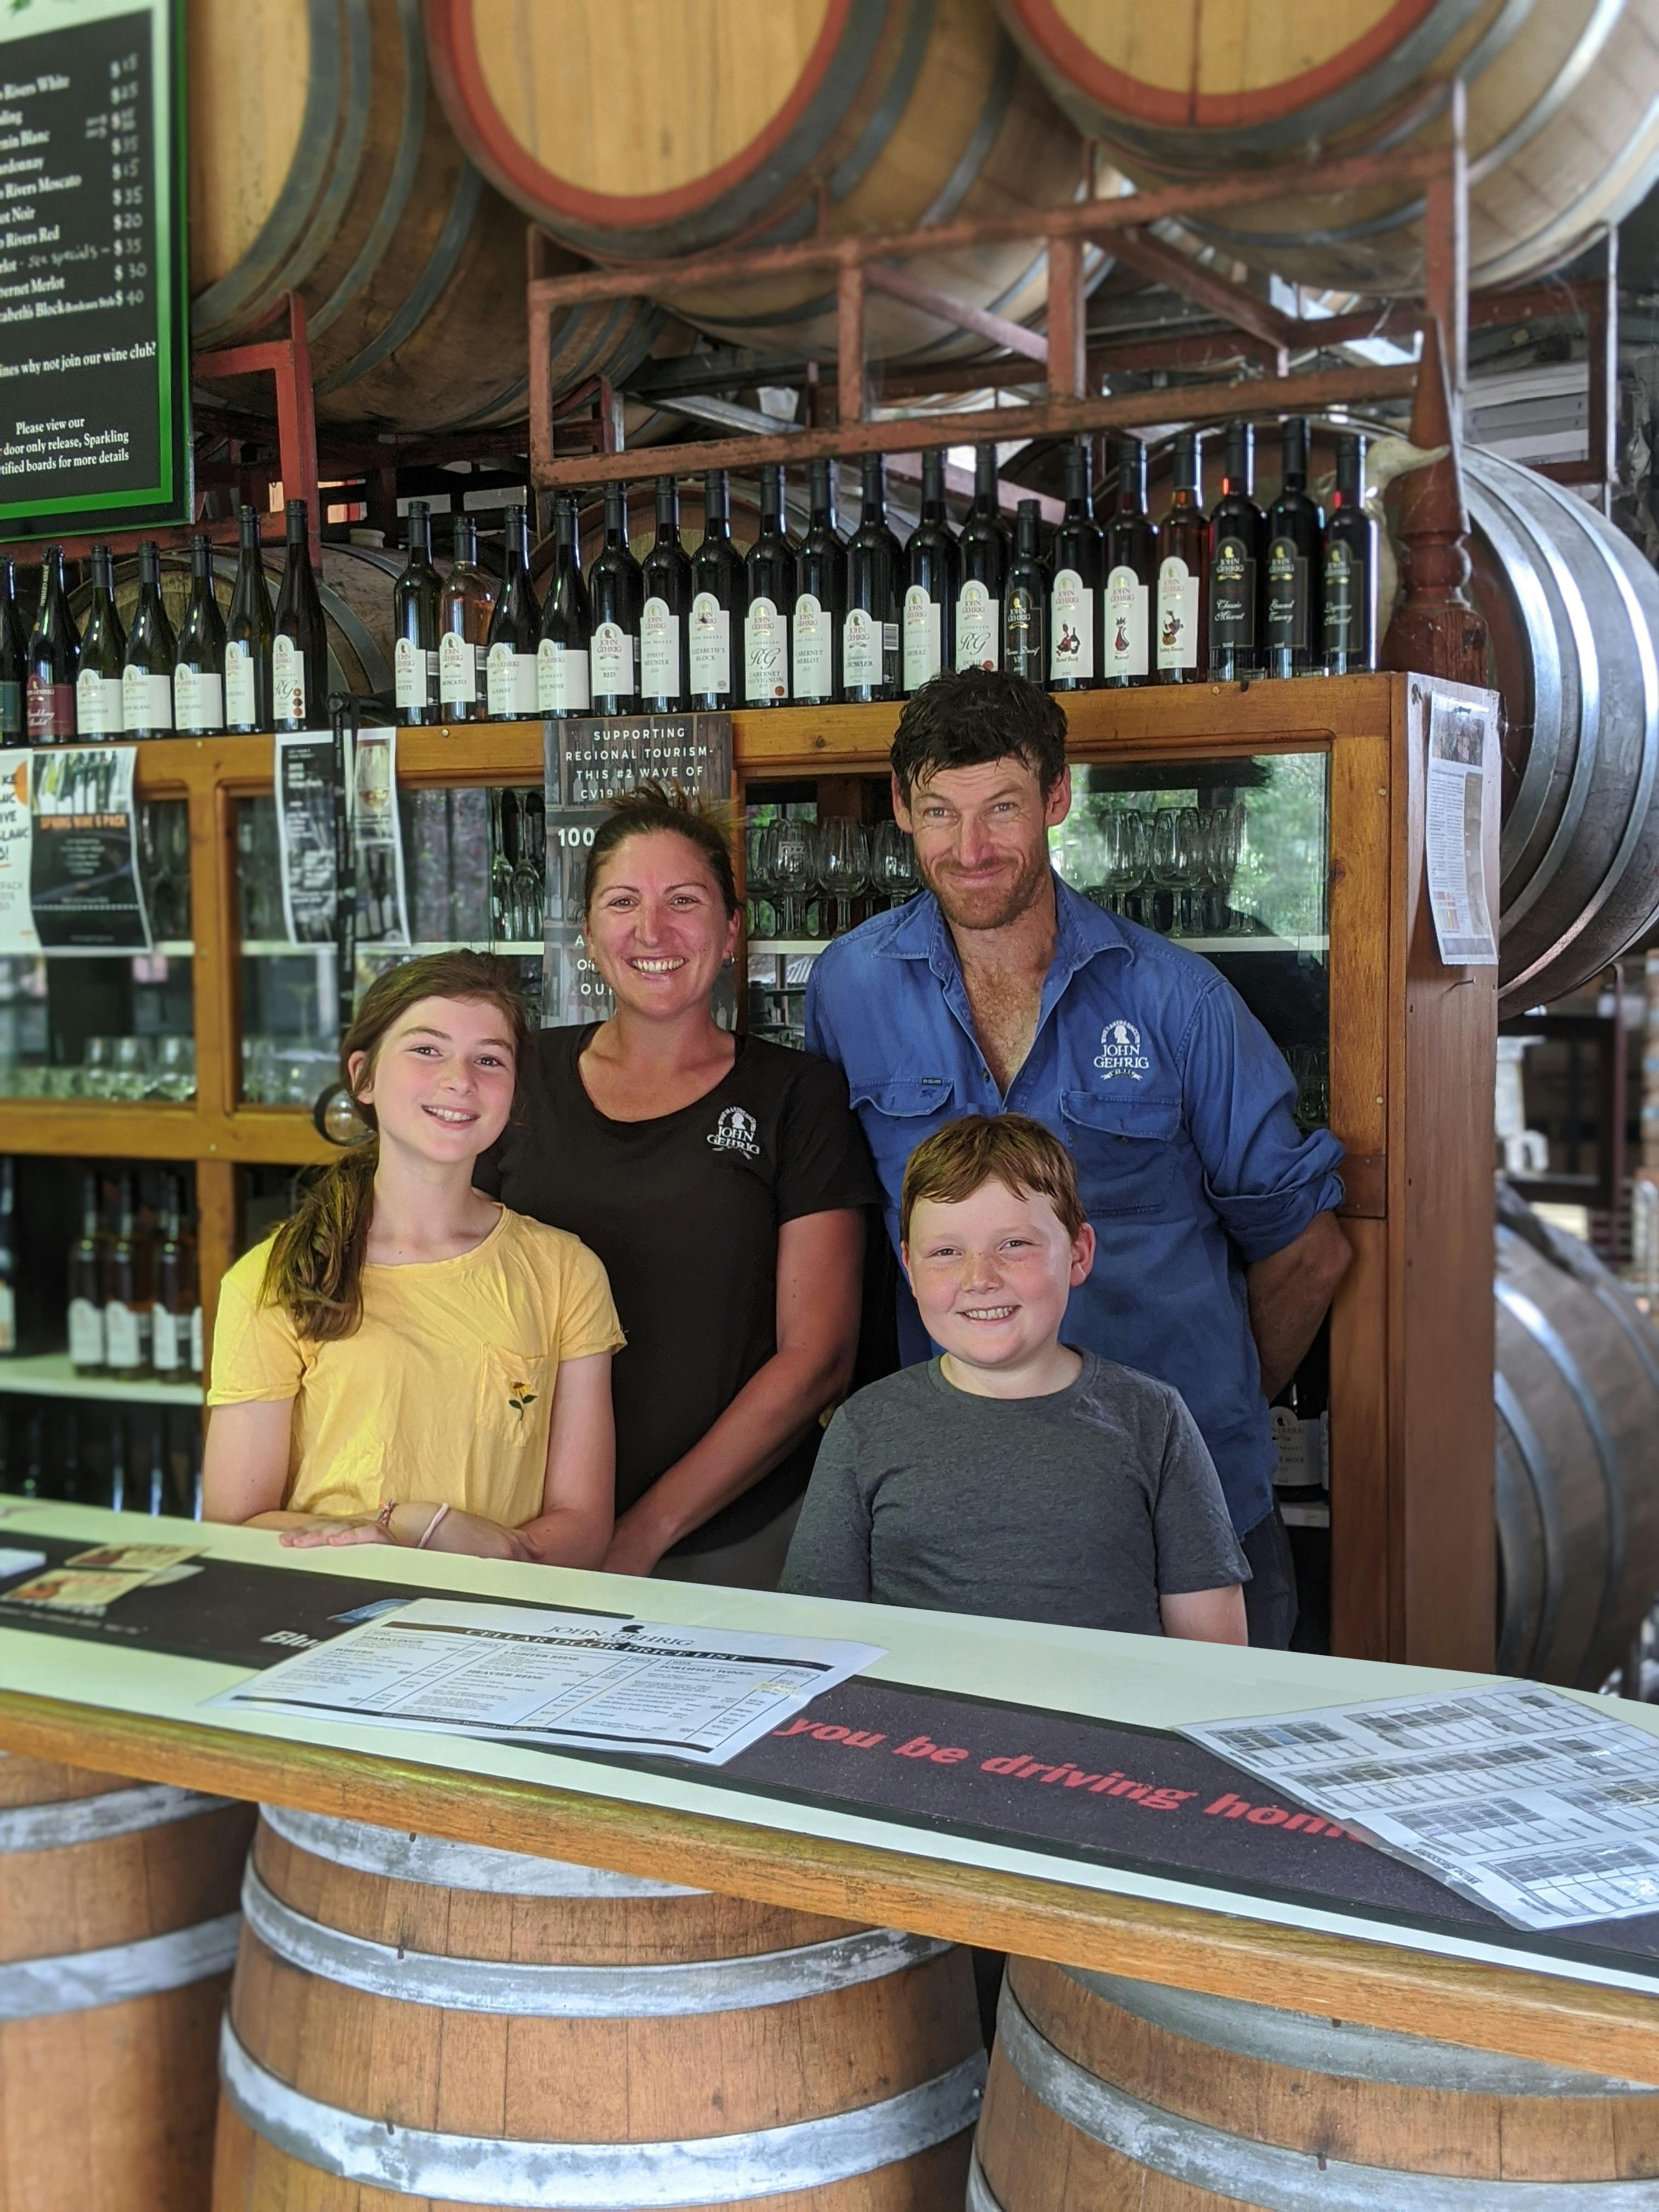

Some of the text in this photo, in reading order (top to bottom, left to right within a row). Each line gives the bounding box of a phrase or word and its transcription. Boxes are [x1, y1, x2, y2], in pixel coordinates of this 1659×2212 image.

[37, 75, 70, 92] White
[20, 130, 50, 146] Blanc
[5, 183, 37, 199] Rivers
[38, 174, 82, 193] Moscato
[12, 206, 36, 222] Noir
[123, 213, 143, 228] 20
[6, 231, 37, 249] Rivers
[39, 224, 60, 242] Red
[31, 275, 65, 295] Merlot
[36, 299, 65, 318] Block
[126, 289, 144, 306] 40
[21, 359, 41, 376] why
[43, 357, 59, 371] not
[60, 353, 81, 373] join
[83, 353, 101, 366] our
[103, 348, 128, 363] wine
[16, 418, 85, 435] Please view our
[3, 429, 129, 456] door only release, Sparkling
[26, 456, 57, 472] boards
[59, 455, 72, 469] for
[74, 455, 97, 466] more
[99, 448, 129, 464] details
[594, 728, 685, 741] SUPPORTING
[566, 746, 713, 761] REGIONAL TOURISM-
[577, 766, 703, 780] THIS #2 WAVE OF
[580, 789, 613, 799] CV19
[581, 983, 612, 995] OU
[1102, 1044, 1141, 1057] JOHN
[1093, 1056, 1149, 1069] GEHRIG
[719, 1126, 755, 1142] JOHN
[544, 1626, 695, 1646] JOHN GEHRIG
[465, 1629, 744, 1661] CELLAR DOOR PRICE LIST
[504, 1651, 550, 1659] LIGHTER
[466, 1669, 514, 1678] HEAVIER
[772, 1714, 879, 1749] you
[894, 1736, 968, 1764] be
[980, 1755, 1200, 1809] driving
